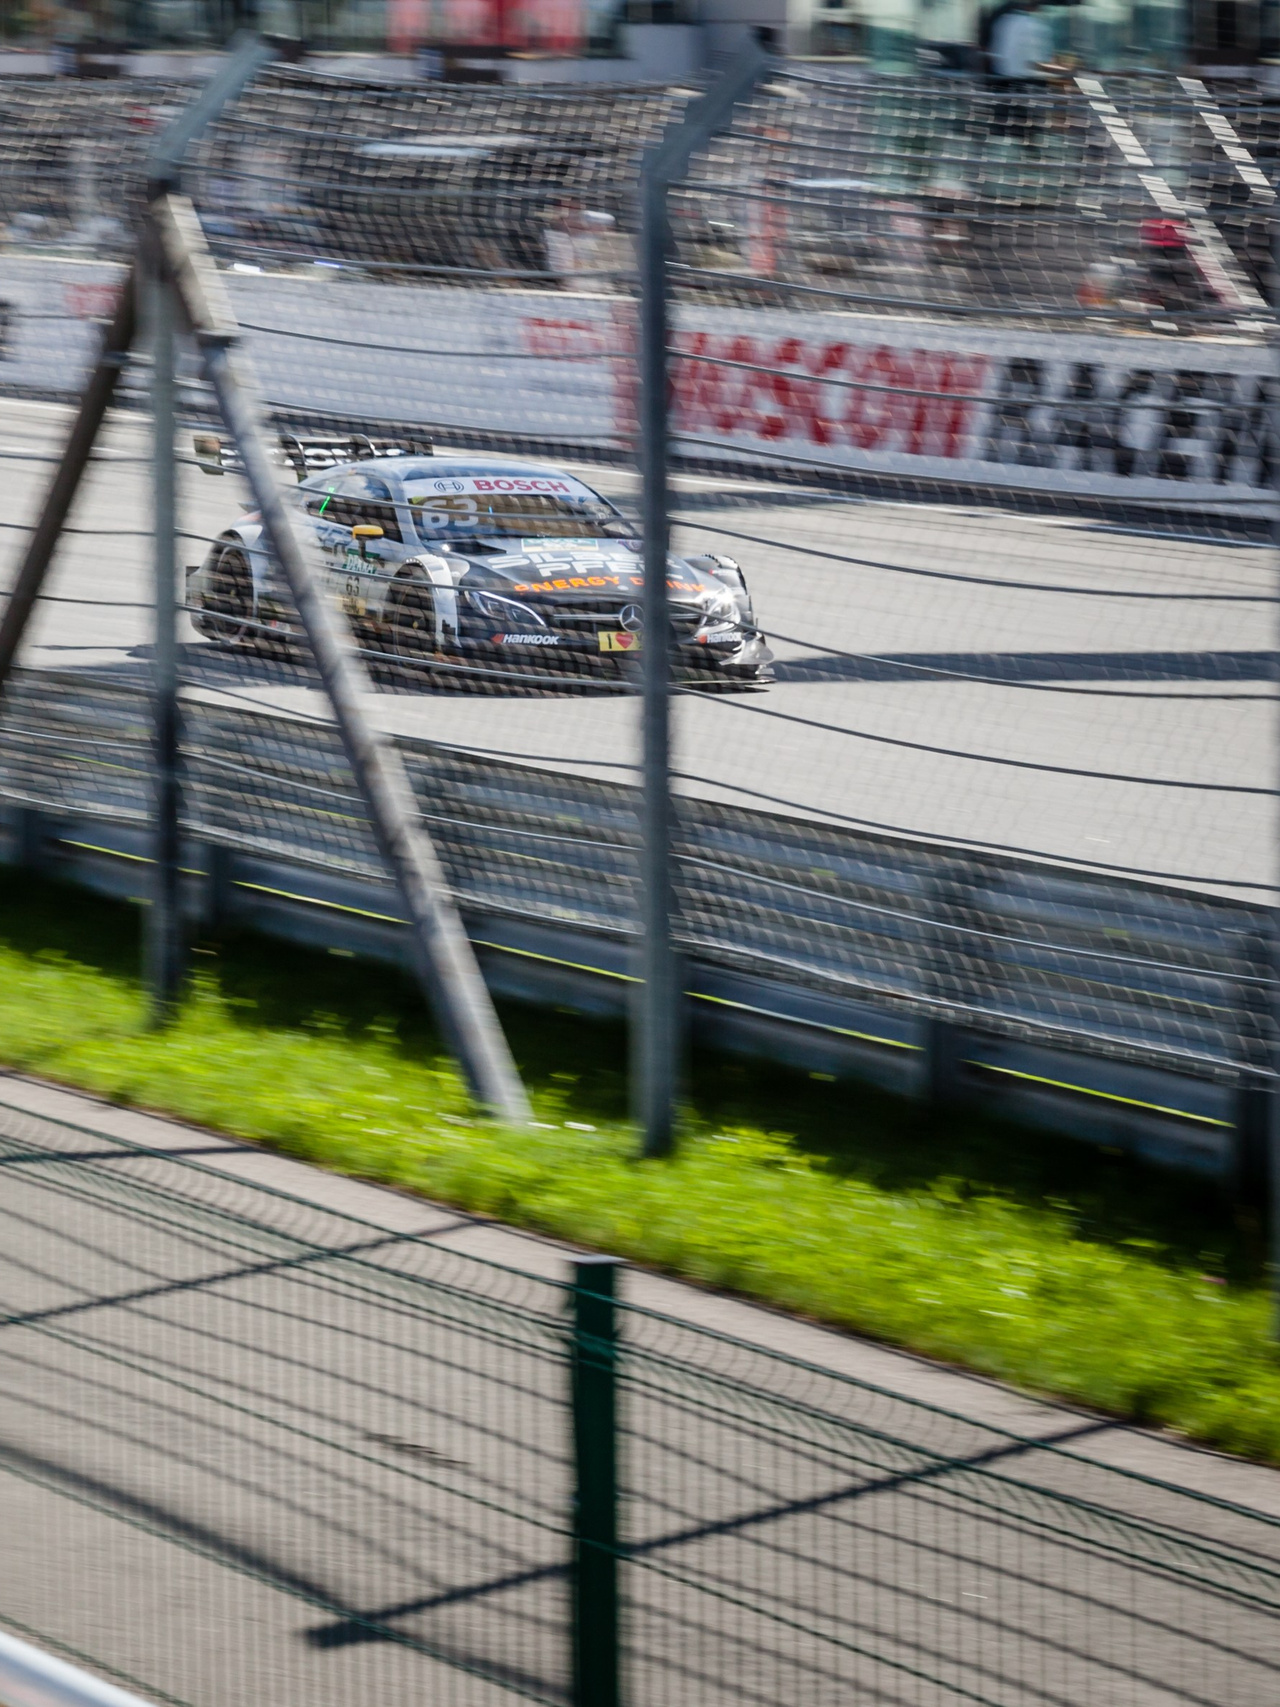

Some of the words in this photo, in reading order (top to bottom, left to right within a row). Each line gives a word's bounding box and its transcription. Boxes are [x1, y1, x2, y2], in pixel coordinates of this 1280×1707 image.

[473, 479, 571, 493] BOSCH
[422, 498, 480, 529] 63
[345, 576, 360, 596] 63
[629, 577, 705, 592] DINK
